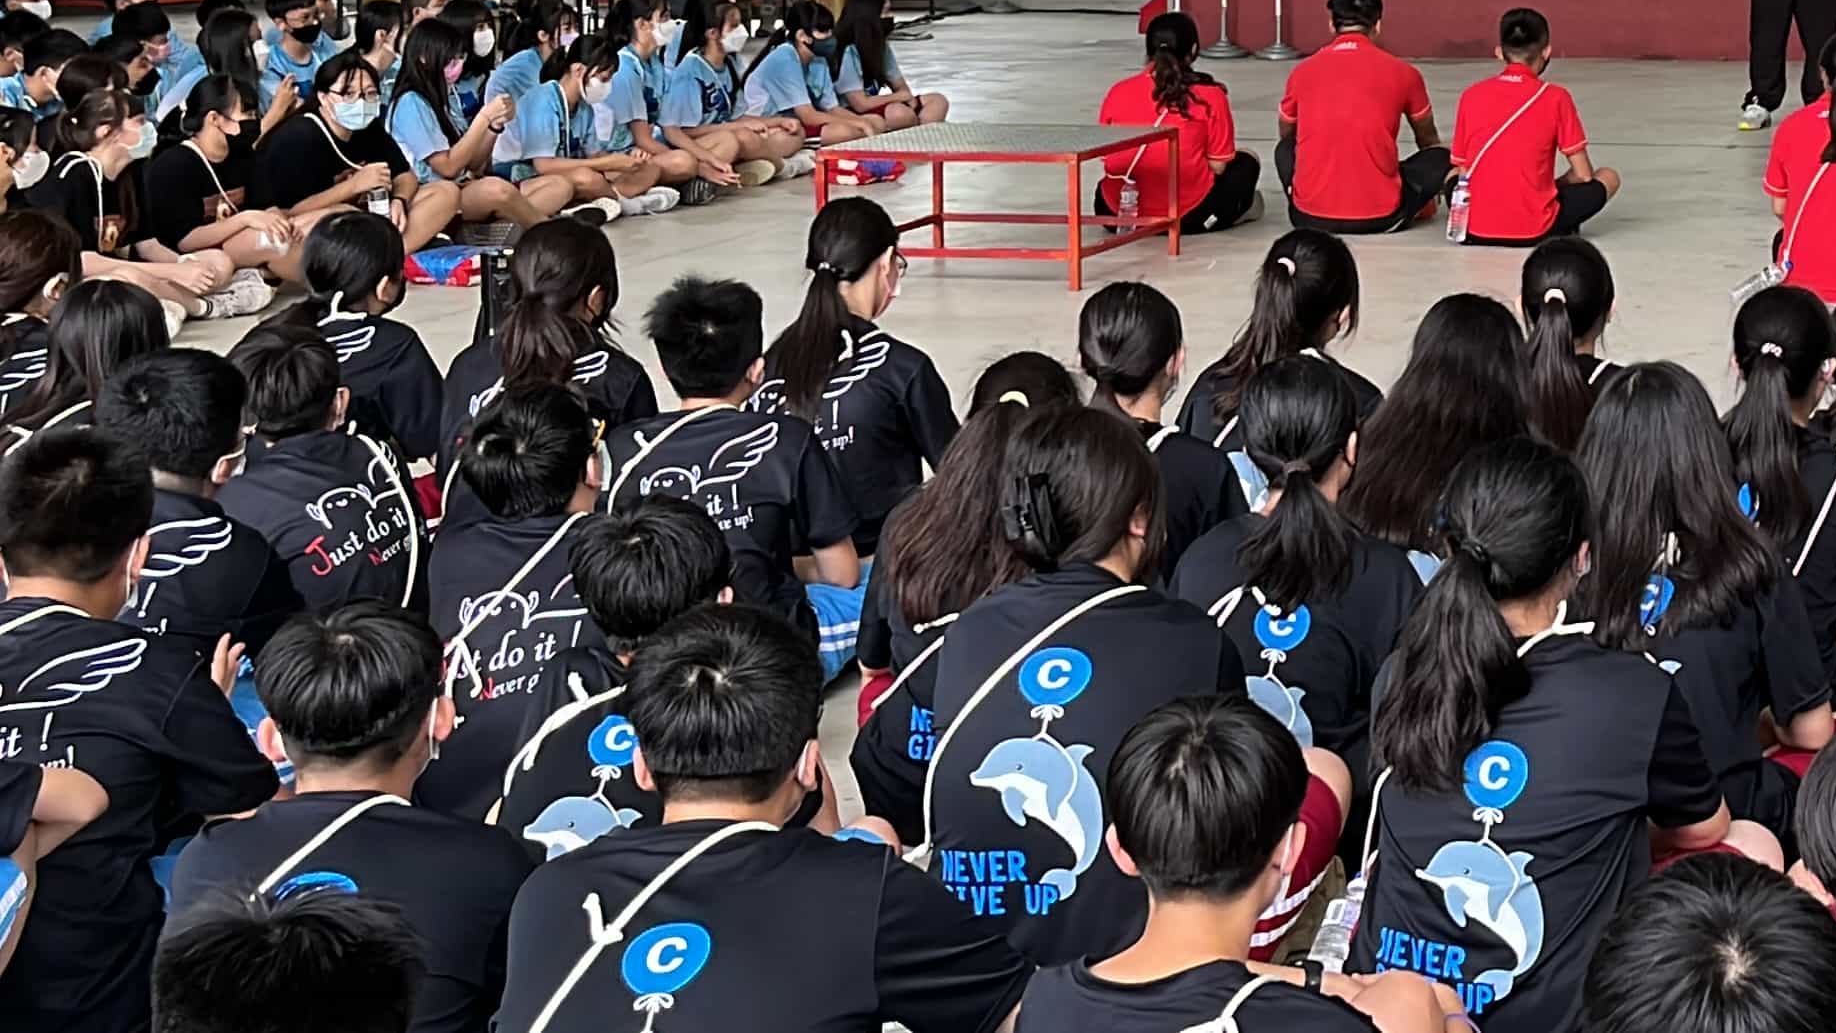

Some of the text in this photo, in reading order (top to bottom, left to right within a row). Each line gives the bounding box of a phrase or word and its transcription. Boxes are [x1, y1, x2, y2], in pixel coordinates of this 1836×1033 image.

[304, 507, 407, 575] Just do it
[489, 629, 525, 671] do
[534, 632, 557, 662] it
[1037, 658, 1069, 691] C
[606, 728, 635, 749] C
[1478, 756, 1511, 790] C
[941, 851, 1028, 883] NEVER
[1024, 884, 1059, 915] UP
[646, 937, 687, 973] C
[1376, 927, 1466, 978] NEVER
